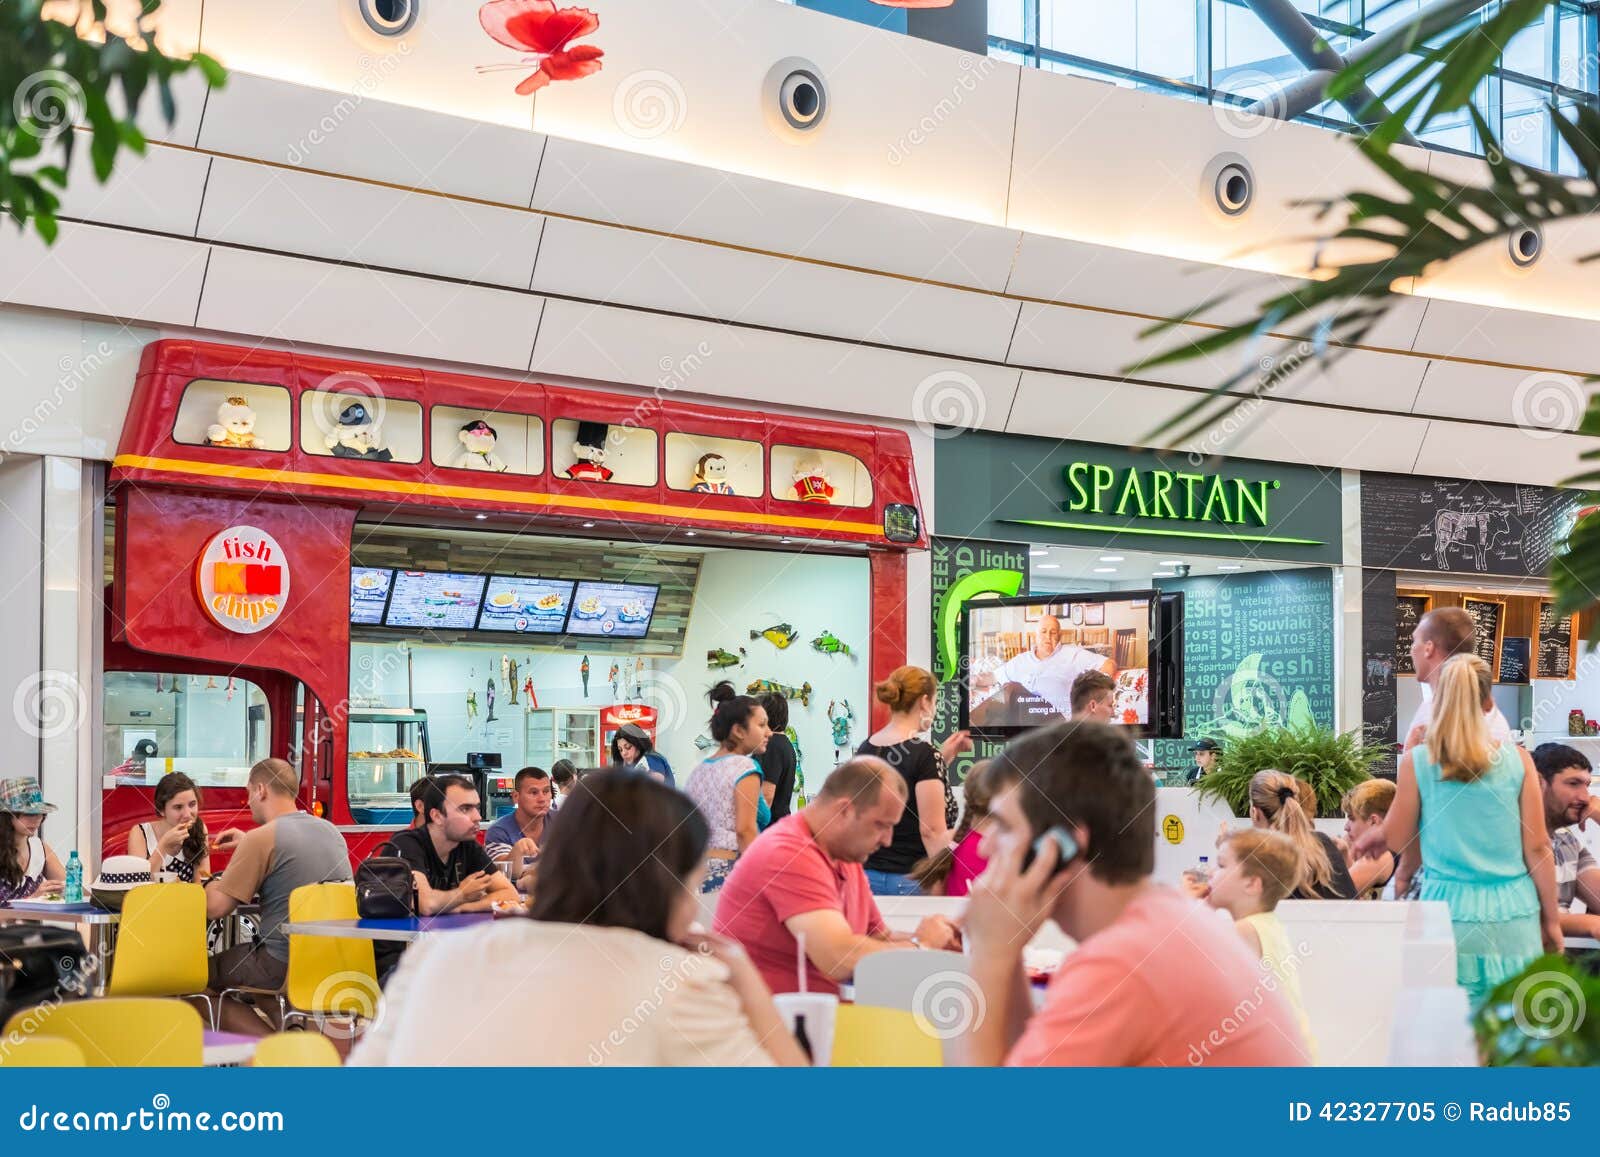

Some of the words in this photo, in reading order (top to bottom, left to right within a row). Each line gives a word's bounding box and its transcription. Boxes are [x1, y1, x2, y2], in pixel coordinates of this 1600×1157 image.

[222, 537, 272, 562] fish
[980, 549, 1024, 570] light
[212, 595, 279, 624] chips
[1184, 599, 1217, 619] ESH
[1217, 587, 1232, 660] verde
[1248, 614, 1312, 632] Souvlaki
[1184, 639, 1208, 654] rtan
[1261, 655, 1314, 676] resh
[1195, 674, 1218, 686] 480
